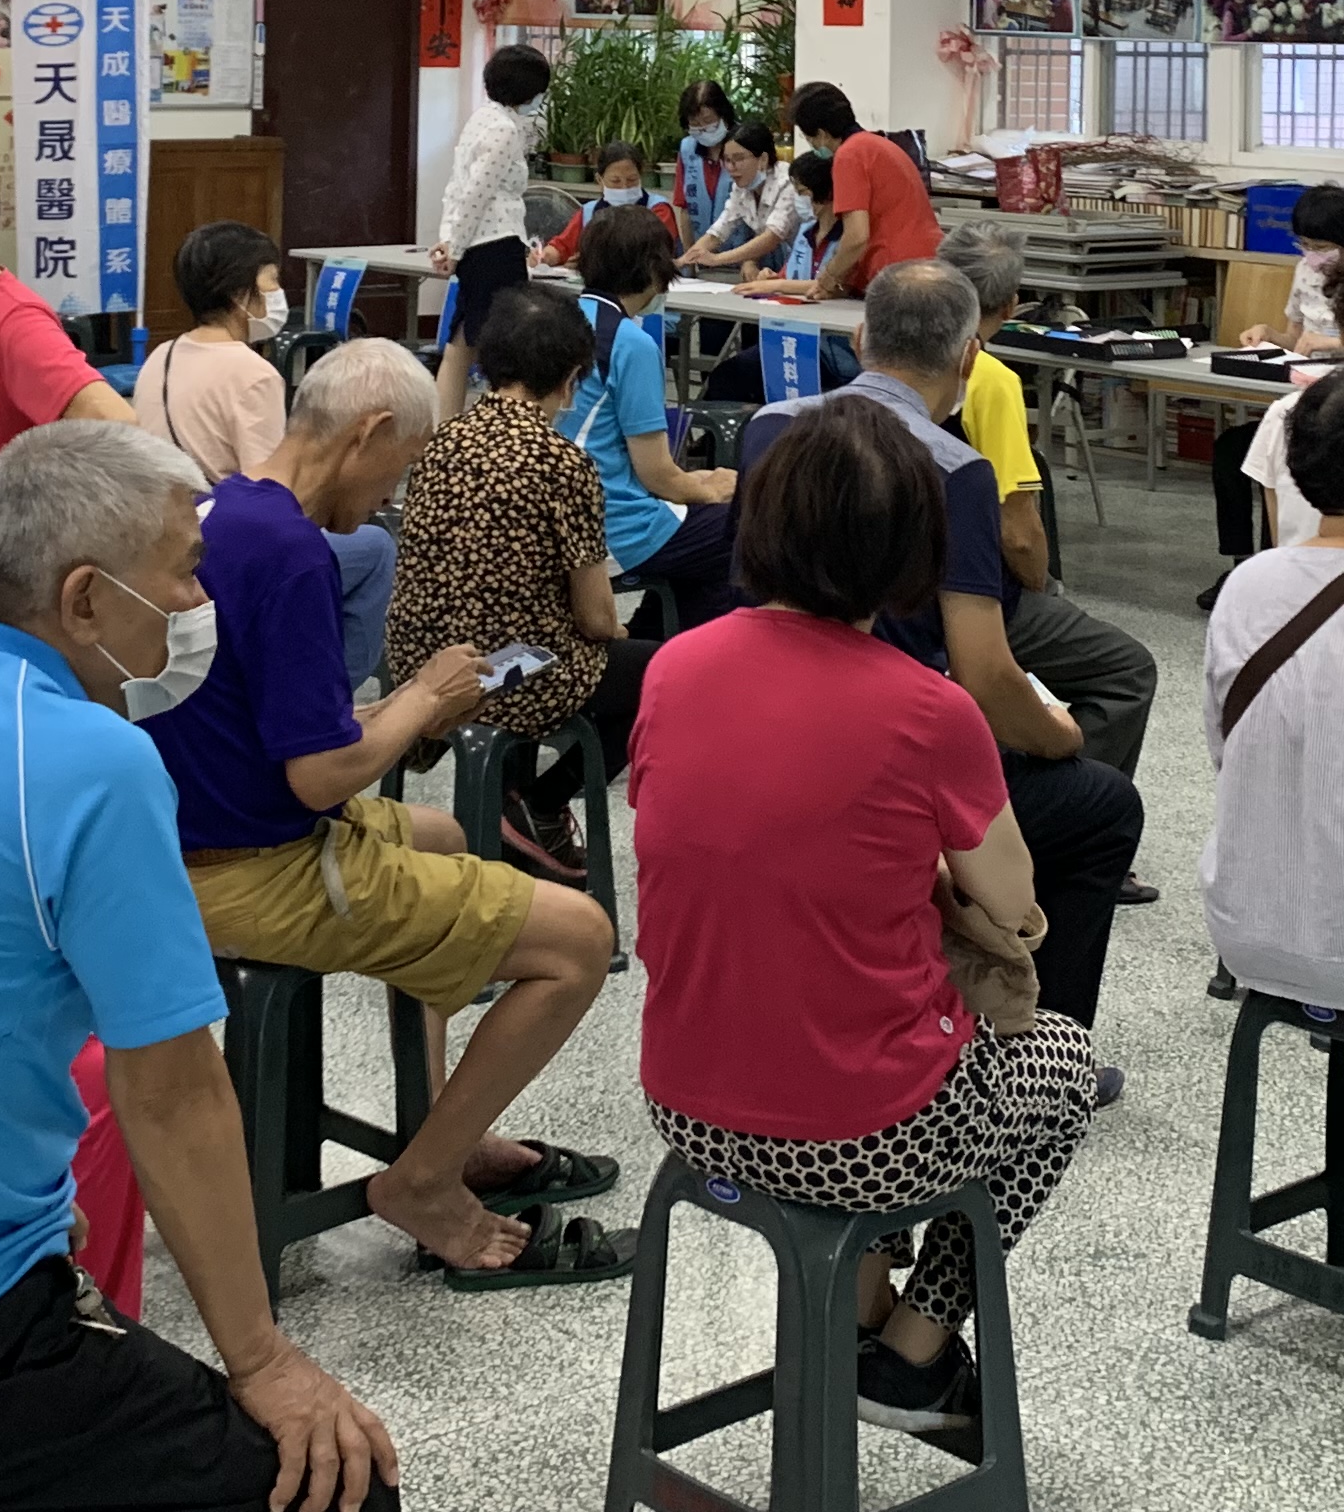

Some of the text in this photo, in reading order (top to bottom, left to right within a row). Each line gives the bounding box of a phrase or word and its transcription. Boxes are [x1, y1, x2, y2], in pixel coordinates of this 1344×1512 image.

[33, 62, 78, 279] 天晟醫院
[102, 6, 132, 274] 天成醫療體系
